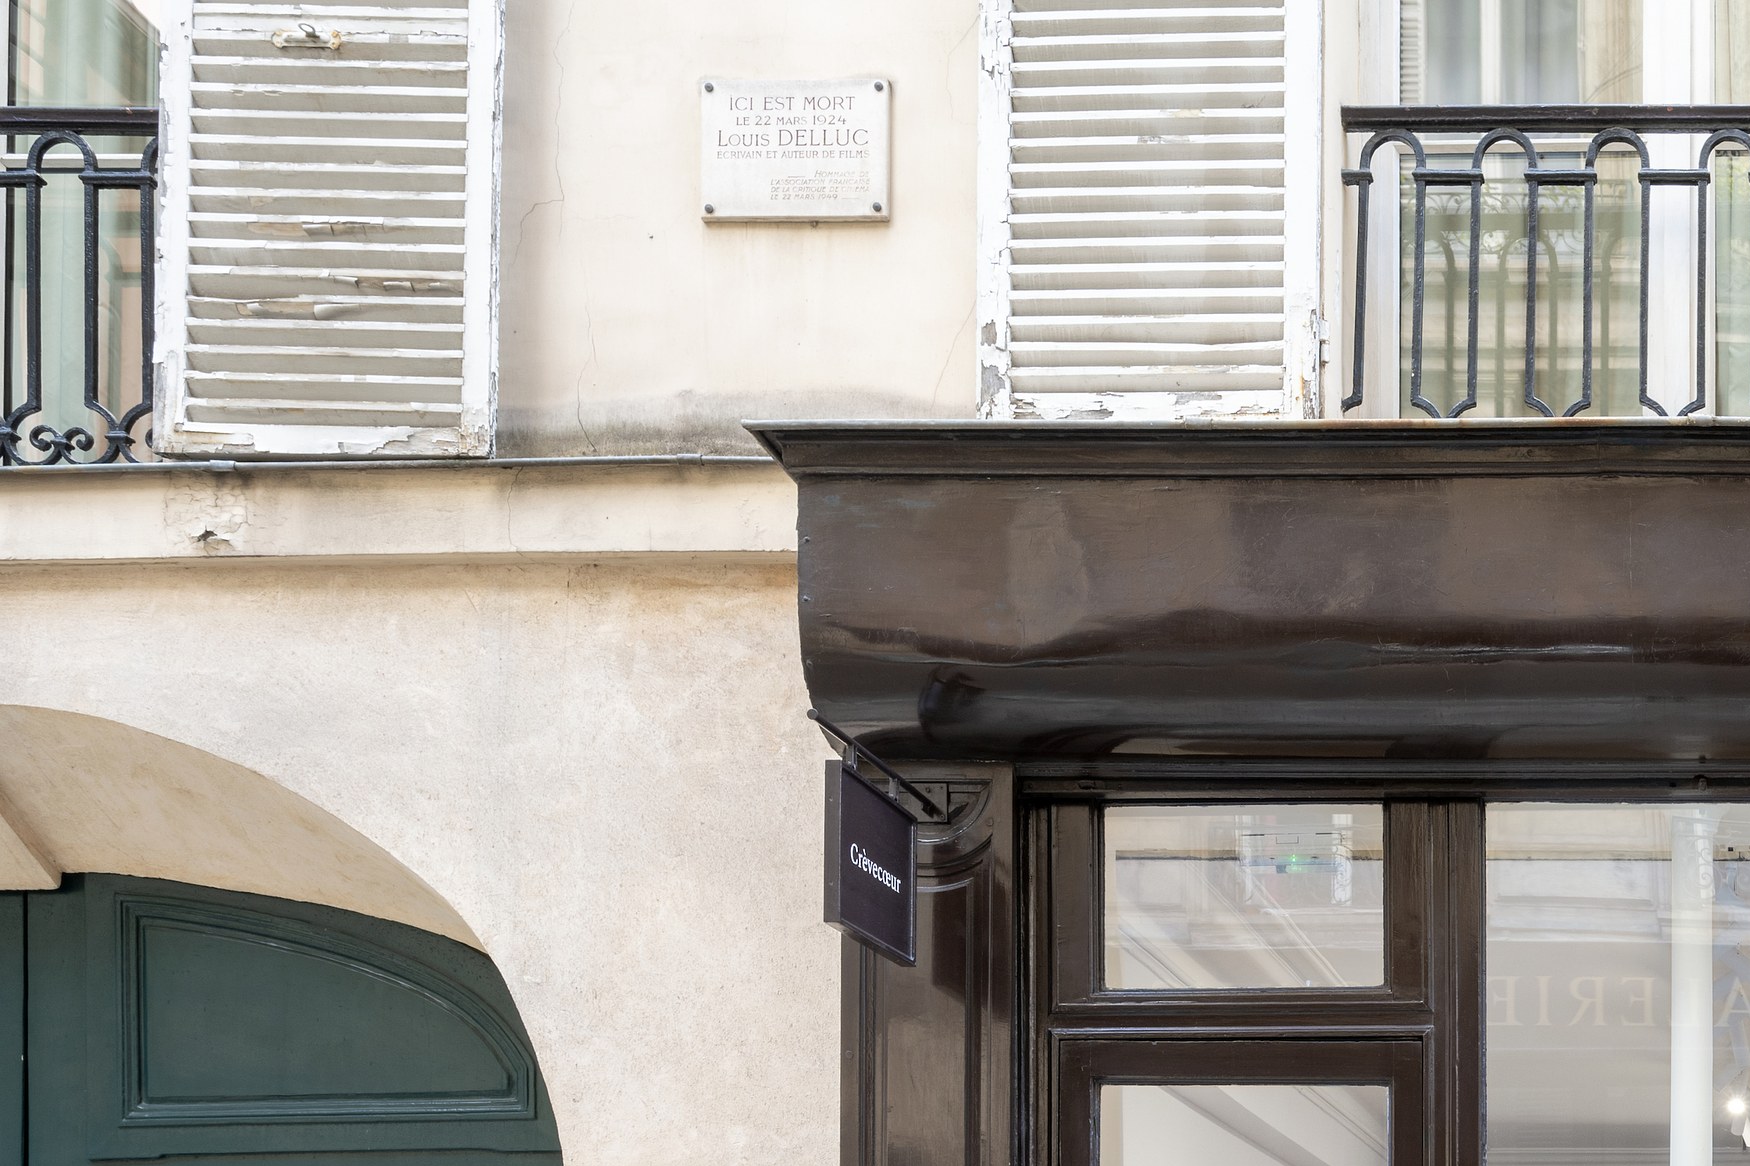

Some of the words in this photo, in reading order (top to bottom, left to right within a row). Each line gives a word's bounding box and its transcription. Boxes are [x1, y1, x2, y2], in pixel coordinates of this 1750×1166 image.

[729, 96, 754, 111] ICI
[763, 97, 795, 111] EST
[803, 96, 856, 111] MORT
[736, 117, 750, 126] LE
[755, 115, 771, 126] 22
[776, 117, 808, 126] MARS
[813, 115, 847, 126] 1924
[718, 130, 770, 147] LOUIS
[778, 129, 869, 147] DELLUC
[766, 150, 778, 159] ET
[781, 150, 819, 159] AUTEUR
[822, 150, 836, 159] DE
[839, 150, 870, 159] FILMS
[850, 842, 901, 894] Crèvecœur
